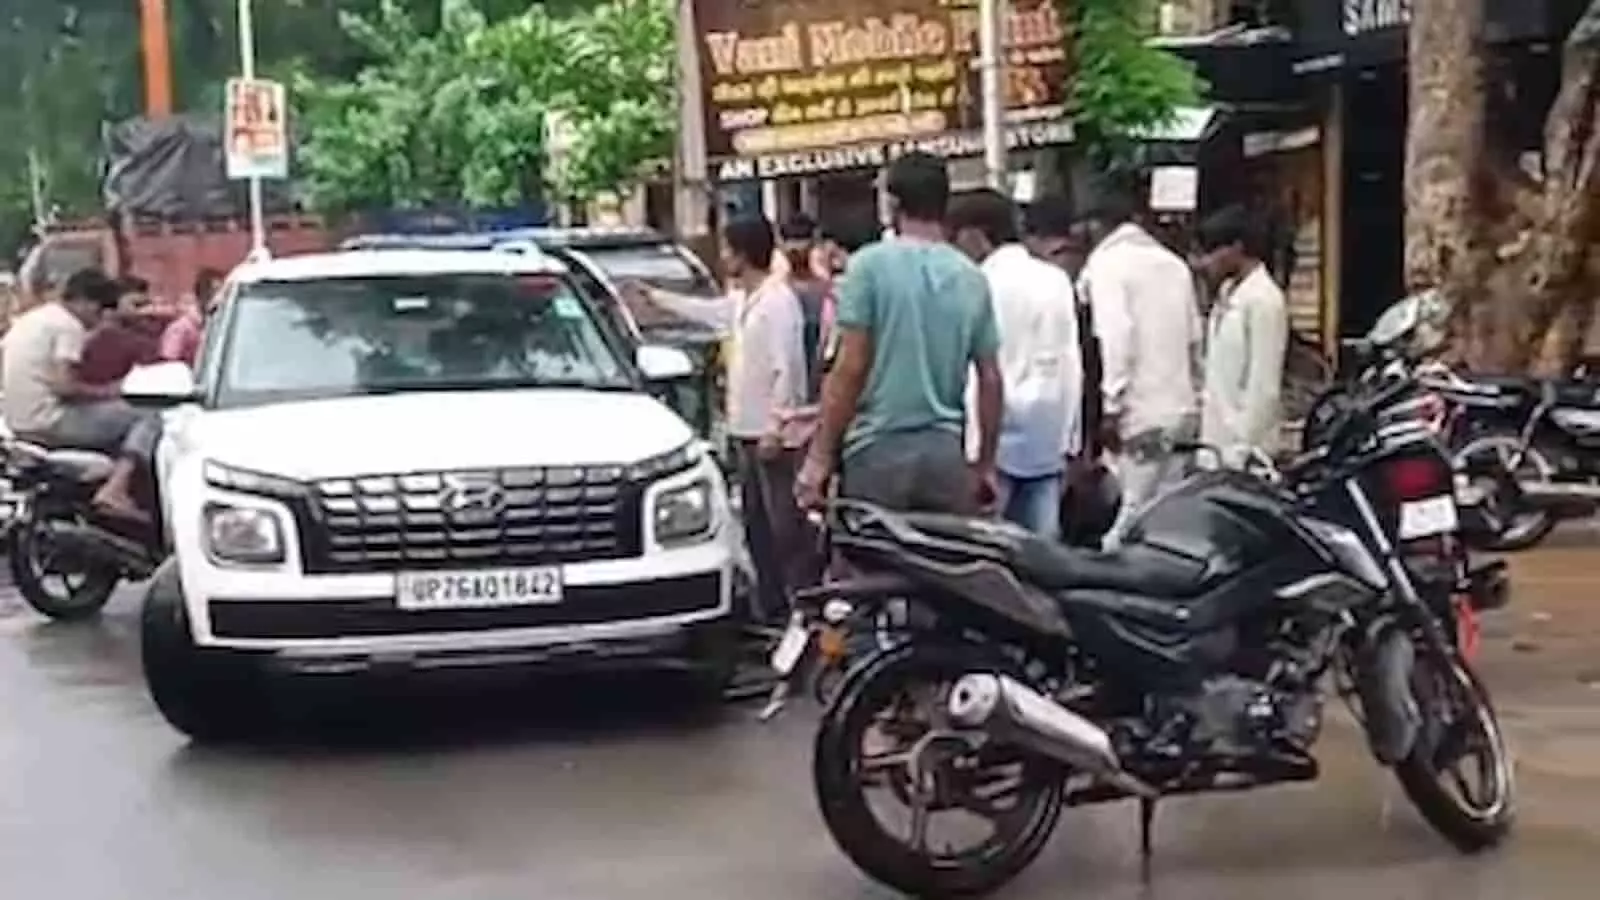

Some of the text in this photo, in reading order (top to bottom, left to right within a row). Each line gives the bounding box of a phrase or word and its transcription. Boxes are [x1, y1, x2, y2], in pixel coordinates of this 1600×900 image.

[810, 13, 946, 66] Mobile
[951, 1, 1063, 50] Pint
[719, 159, 754, 181] AN
[759, 146, 883, 177] EXCLUSIVE
[1005, 121, 1075, 149] STORE
